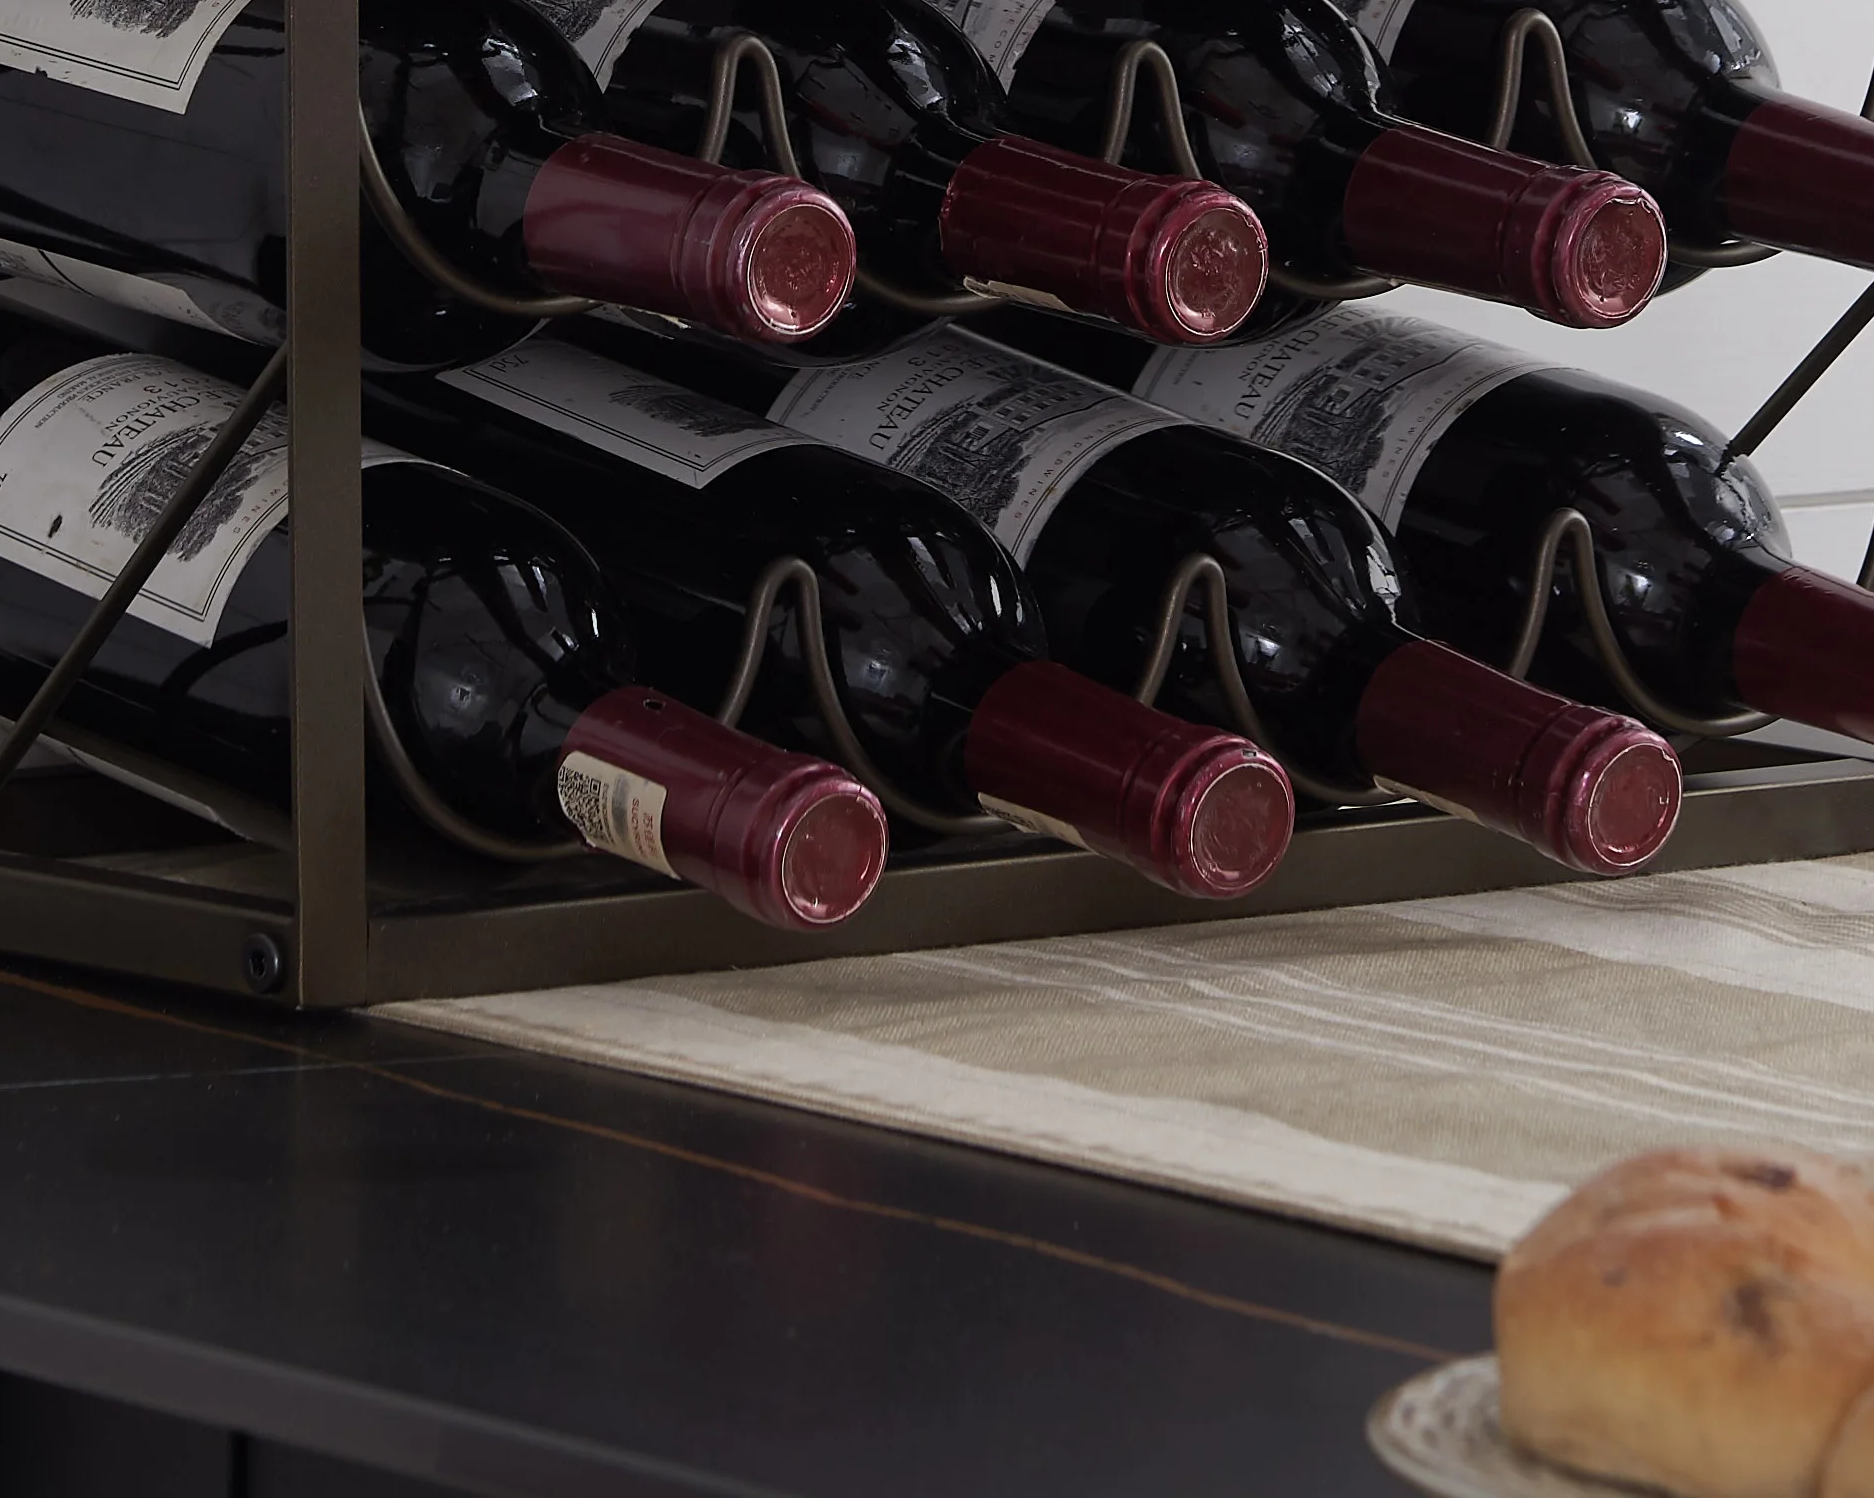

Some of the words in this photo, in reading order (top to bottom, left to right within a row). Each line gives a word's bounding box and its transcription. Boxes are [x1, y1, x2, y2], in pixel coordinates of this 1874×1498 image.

[869, 366, 964, 451] CHATEAU
[1234, 327, 1318, 420] CHATEAU
[93, 394, 200, 468] CHATEAU
